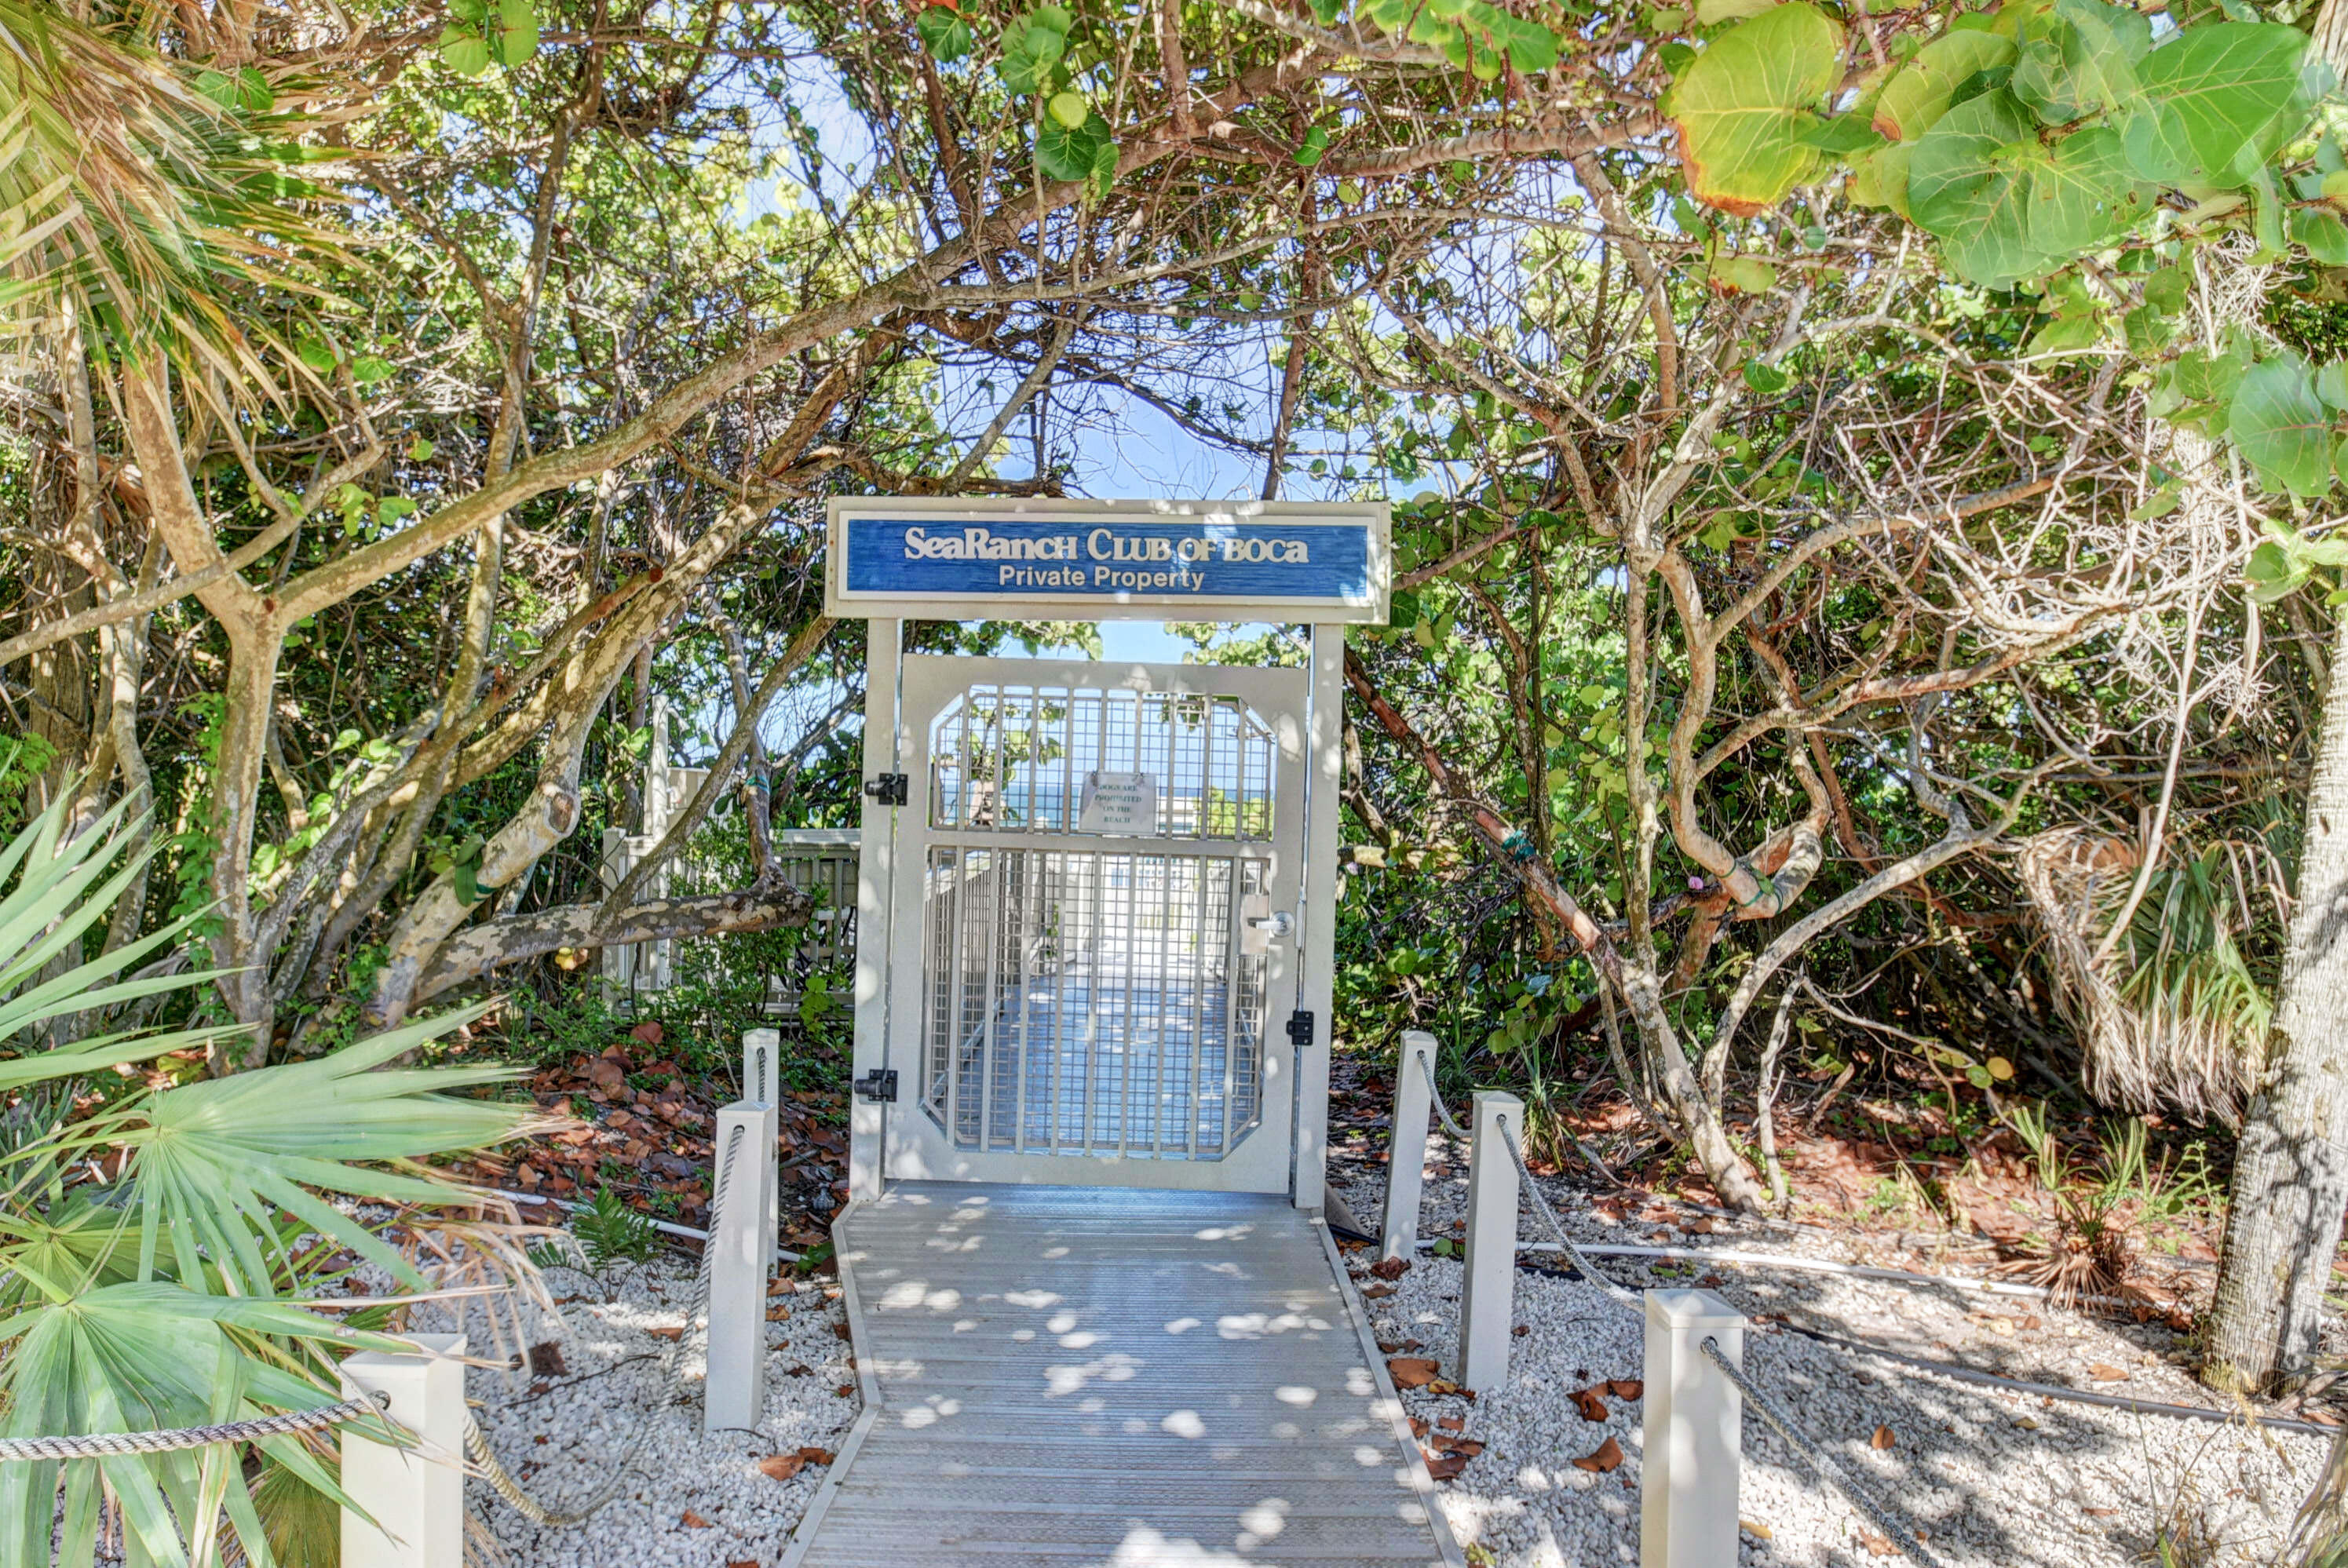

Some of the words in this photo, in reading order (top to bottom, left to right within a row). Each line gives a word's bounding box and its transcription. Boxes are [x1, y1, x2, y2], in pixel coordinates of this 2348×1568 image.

[1178, 538, 1216, 562] OF
[999, 565, 1086, 586] Private
[1094, 566, 1205, 591] Property
